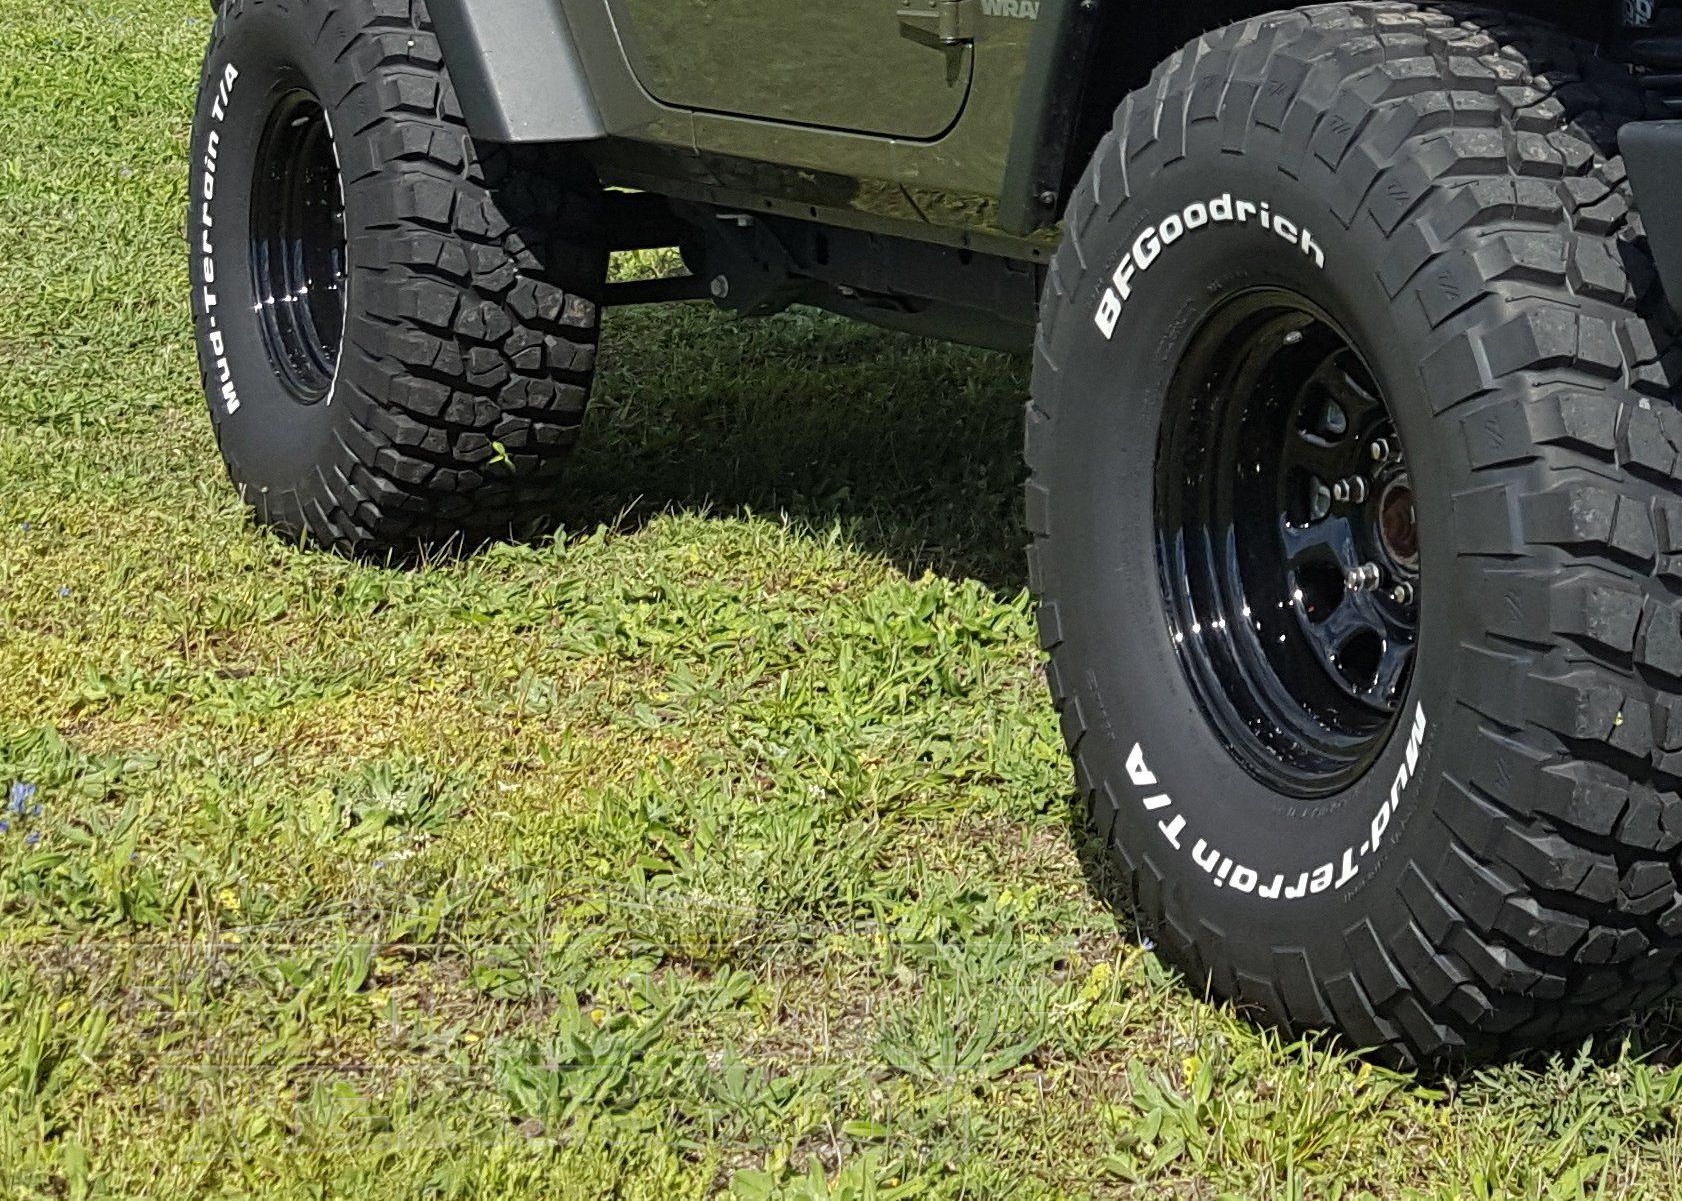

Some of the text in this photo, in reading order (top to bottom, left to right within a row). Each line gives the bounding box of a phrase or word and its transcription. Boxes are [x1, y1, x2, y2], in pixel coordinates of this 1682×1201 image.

[200, 62, 241, 416] Mud-Terrain T/A
[1094, 192, 1326, 342] BFGoodrich
[1124, 698, 1427, 900] Mud-Terrain T/A
